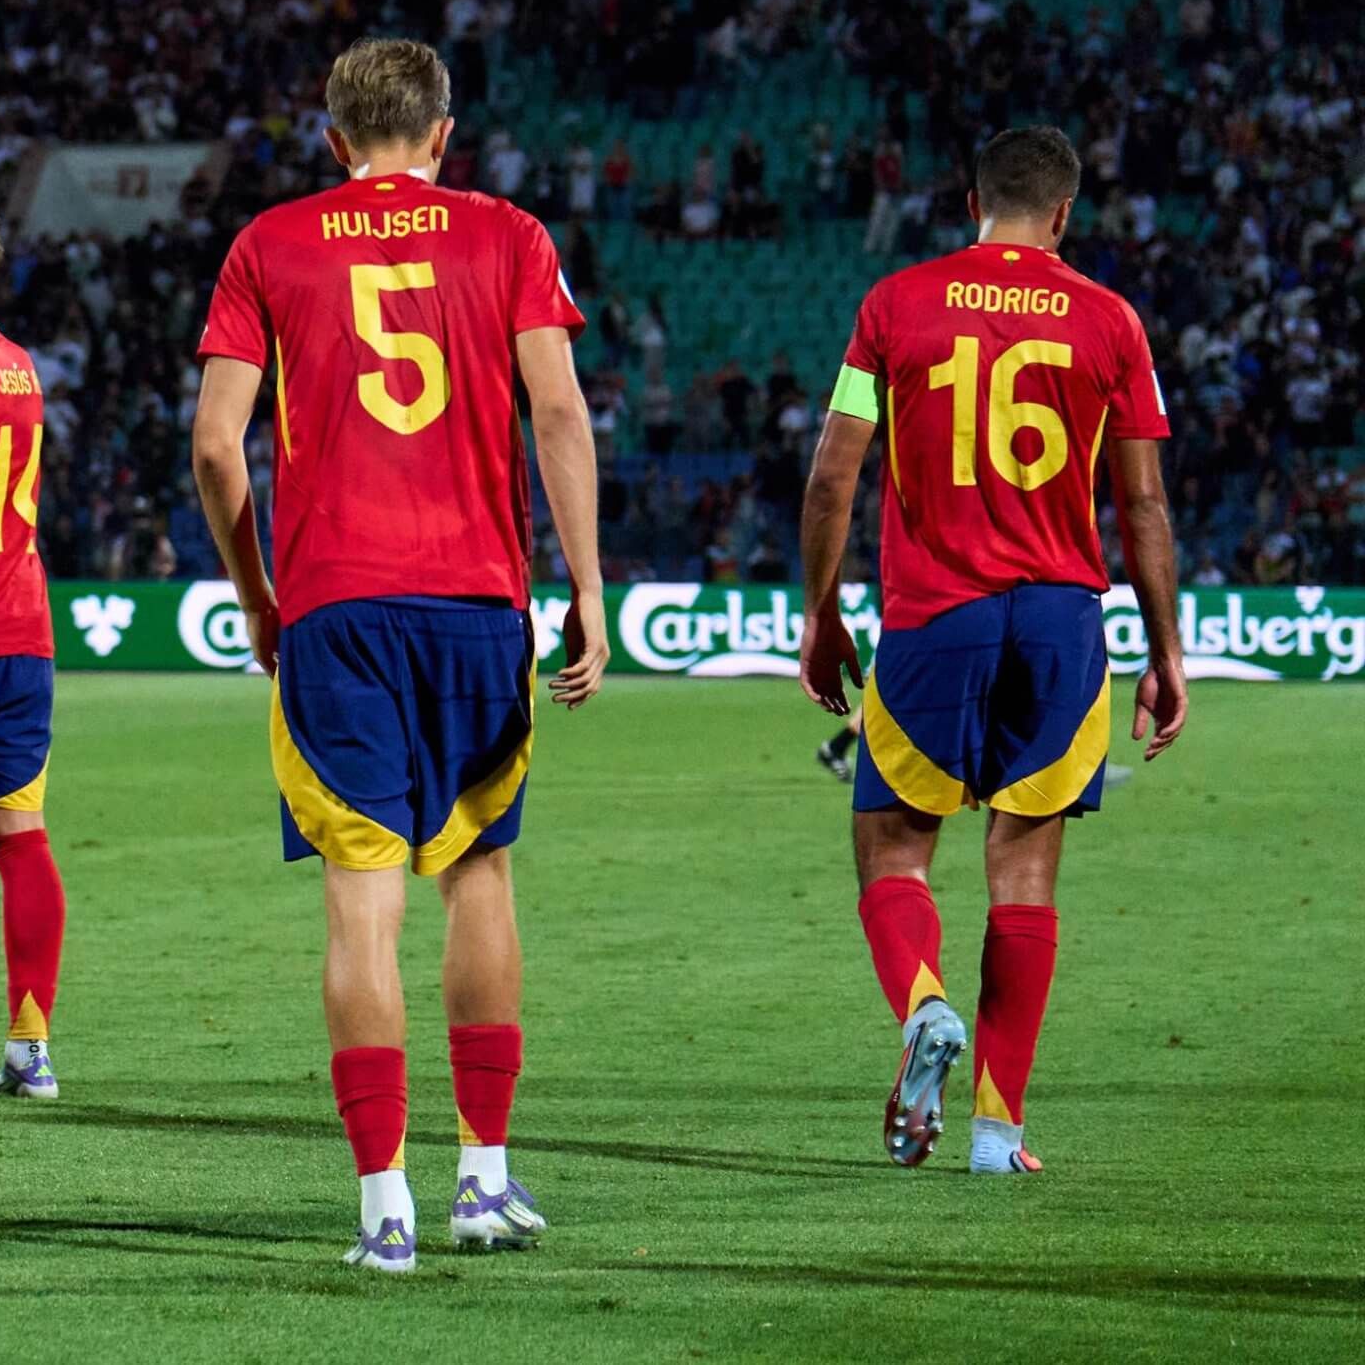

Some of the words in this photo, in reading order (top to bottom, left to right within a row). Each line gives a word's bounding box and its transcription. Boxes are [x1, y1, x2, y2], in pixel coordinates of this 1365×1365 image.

[350, 261, 450, 435] 5
[946, 281, 1070, 317] RODRIGO
[929, 335, 1072, 492] 16
